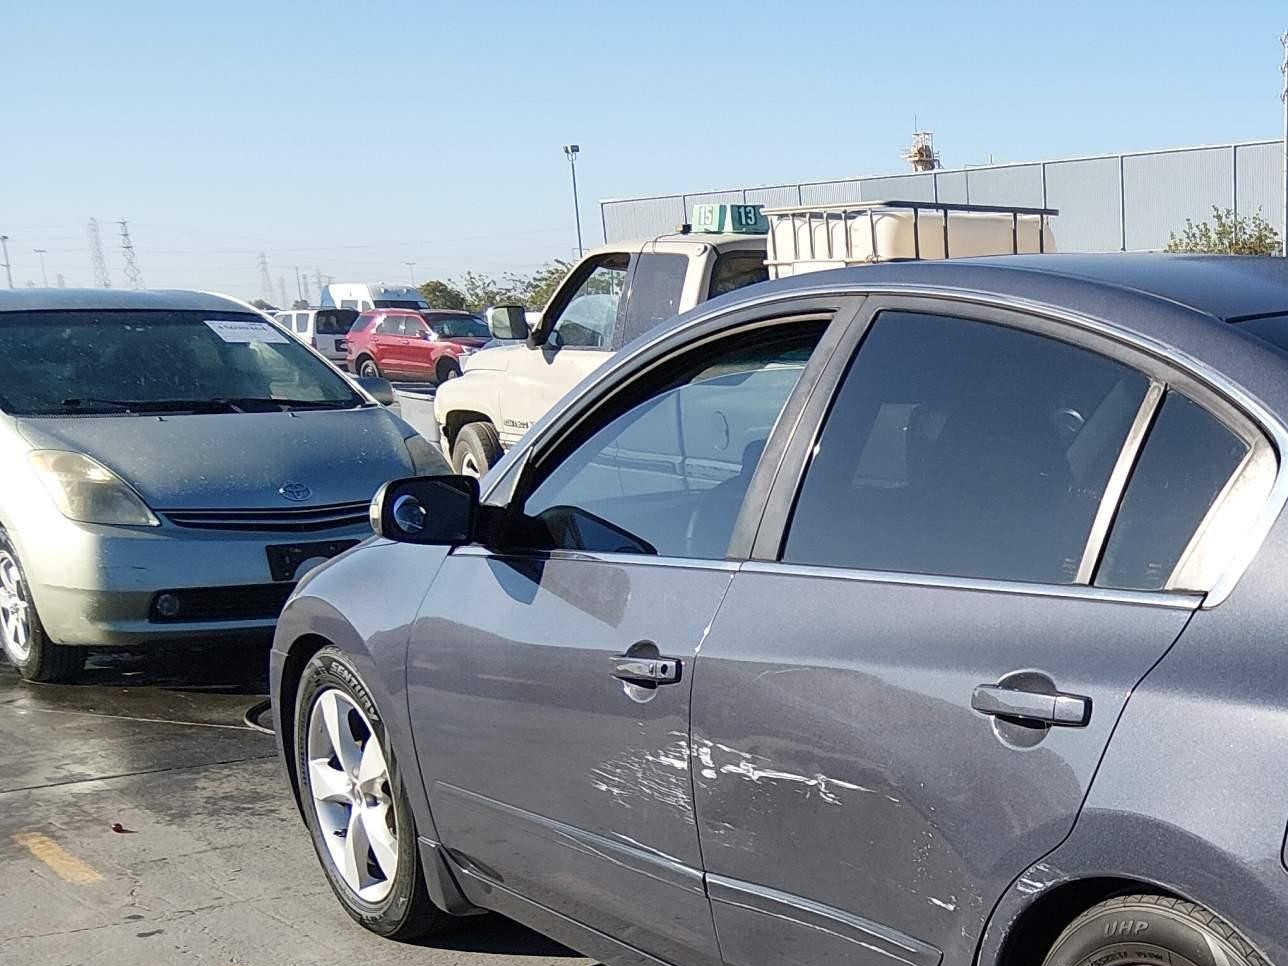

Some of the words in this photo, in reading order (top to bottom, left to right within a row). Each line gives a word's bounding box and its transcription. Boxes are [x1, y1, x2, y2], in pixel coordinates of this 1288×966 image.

[699, 206, 713, 226] 15
[738, 206, 757, 226] 13
[330, 661, 379, 721] SENTURY
[1103, 918, 1151, 938] UHP
